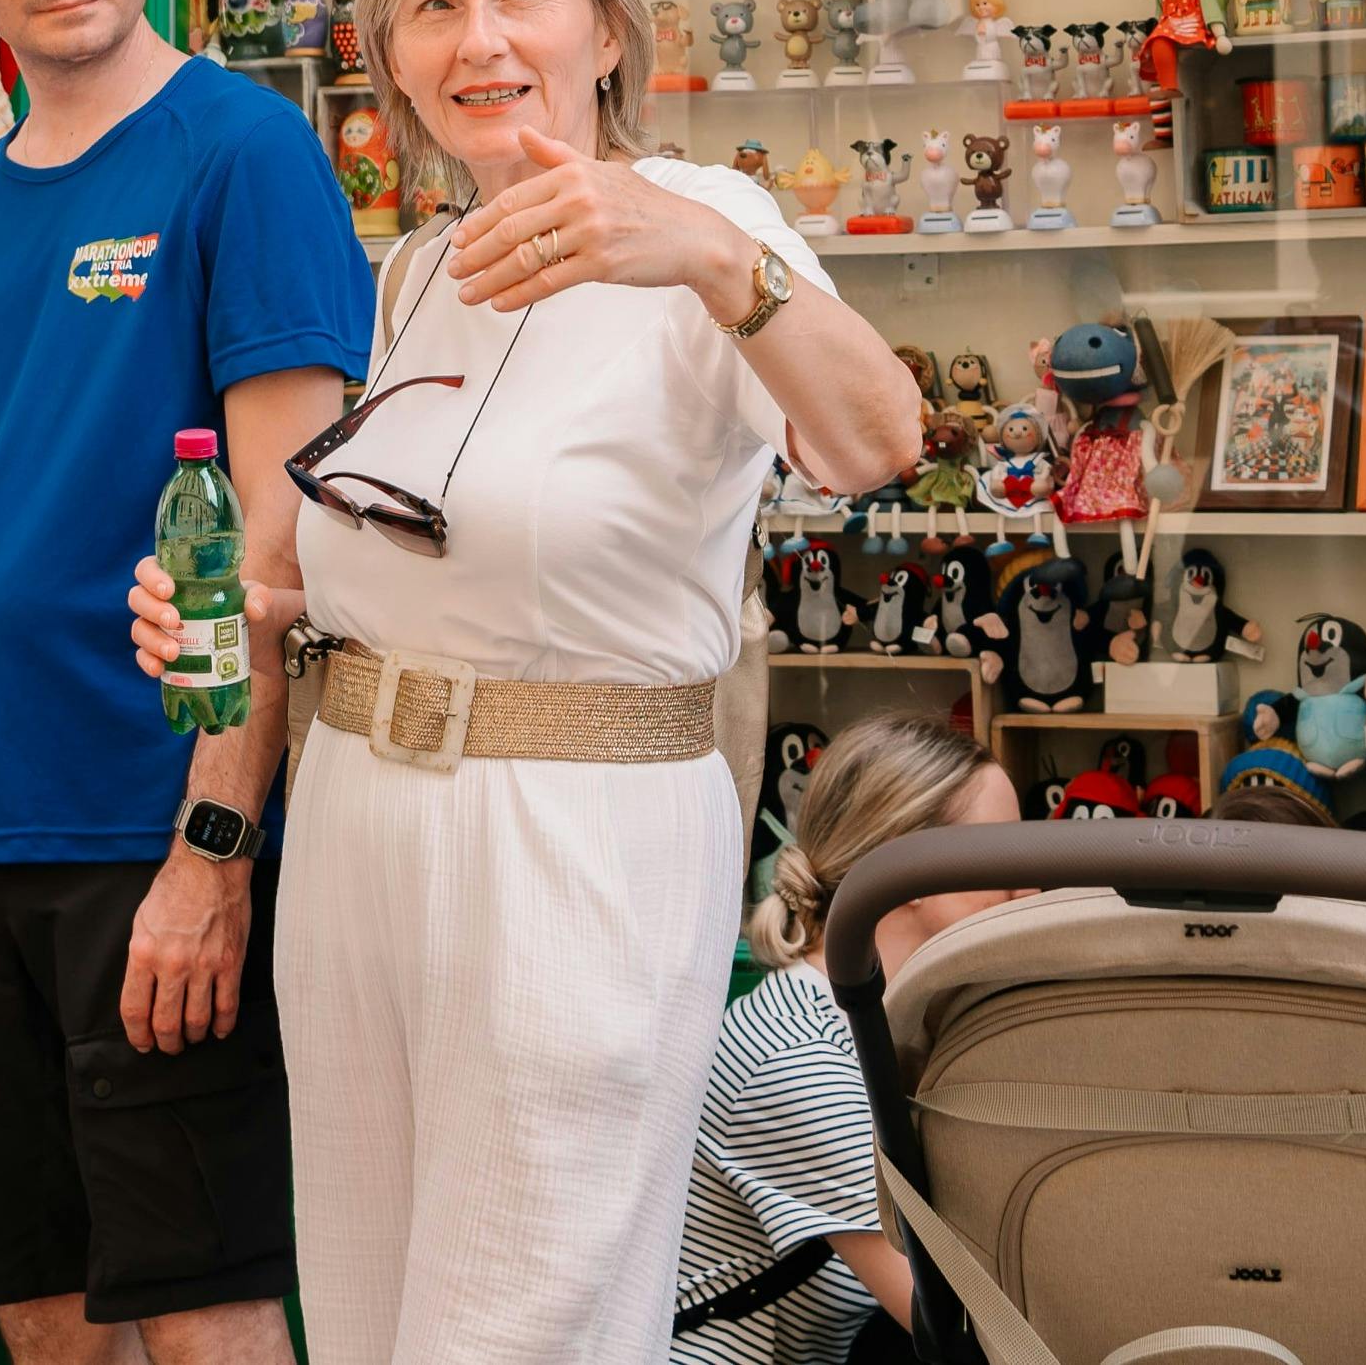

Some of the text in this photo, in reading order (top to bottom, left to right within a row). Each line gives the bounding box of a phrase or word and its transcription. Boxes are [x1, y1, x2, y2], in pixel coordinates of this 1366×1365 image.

[91, 259, 133, 272] AUSTRIA
[1136, 823, 1253, 849] JOOLZ
[1229, 1267, 1282, 1282] JOOLZ
